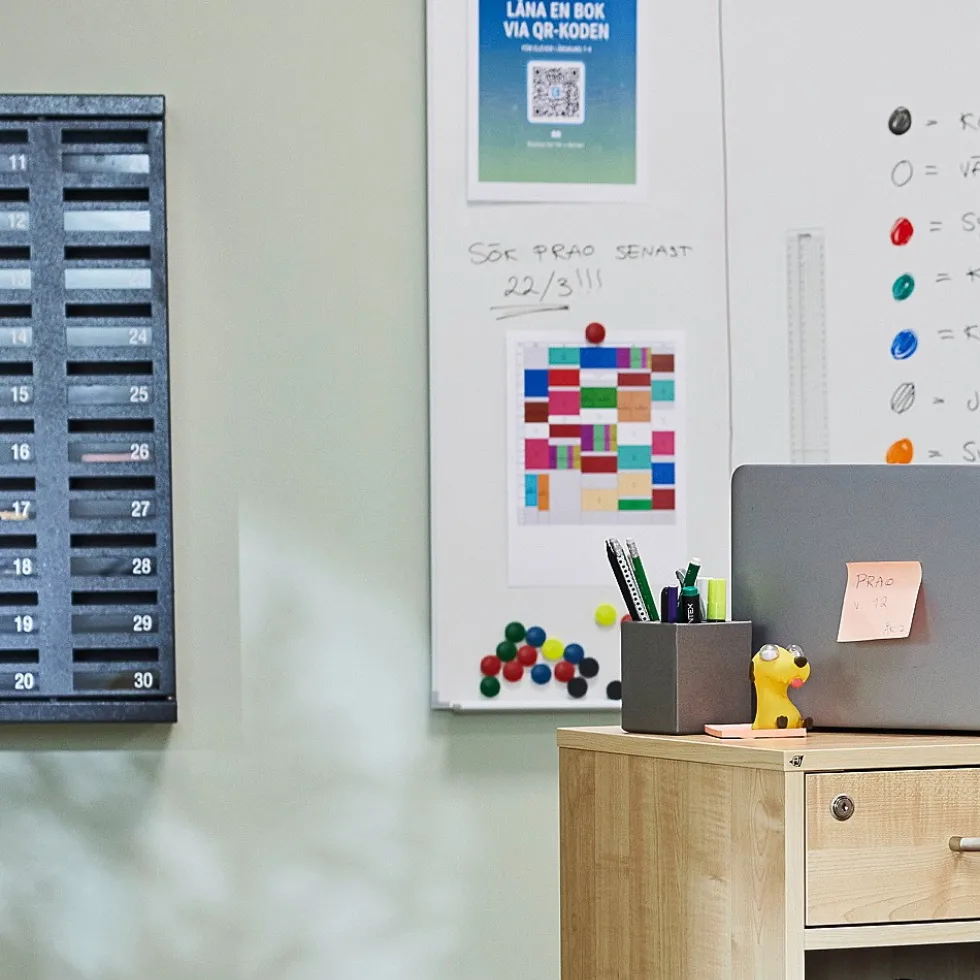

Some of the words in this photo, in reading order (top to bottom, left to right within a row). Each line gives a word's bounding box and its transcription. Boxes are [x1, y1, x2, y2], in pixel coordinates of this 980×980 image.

[550, 1, 570, 19] EN
[574, 2, 606, 20] BOK
[503, 20, 530, 39] VIA
[532, 21, 609, 40] QR-KODEN
[8, 153, 27, 170] 11
[8, 213, 26, 229] 12
[533, 244, 595, 262] PRAO
[615, 244, 694, 261] SENAST
[11, 329, 28, 345] 14
[128, 328, 148, 345] 24
[11, 386, 29, 403] 15
[130, 386, 149, 403] 25
[11, 443, 30, 460] 16
[130, 443, 149, 460] 26
[12, 501, 31, 517] 17
[131, 501, 150, 517] 27
[13, 558, 32, 575] 18
[132, 557, 151, 574] 28
[855, 573, 895, 589] PRAO
[14, 615, 33, 633] 19
[133, 615, 152, 632] 29
[14, 673, 34, 690] 20
[134, 672, 153, 688] 30
